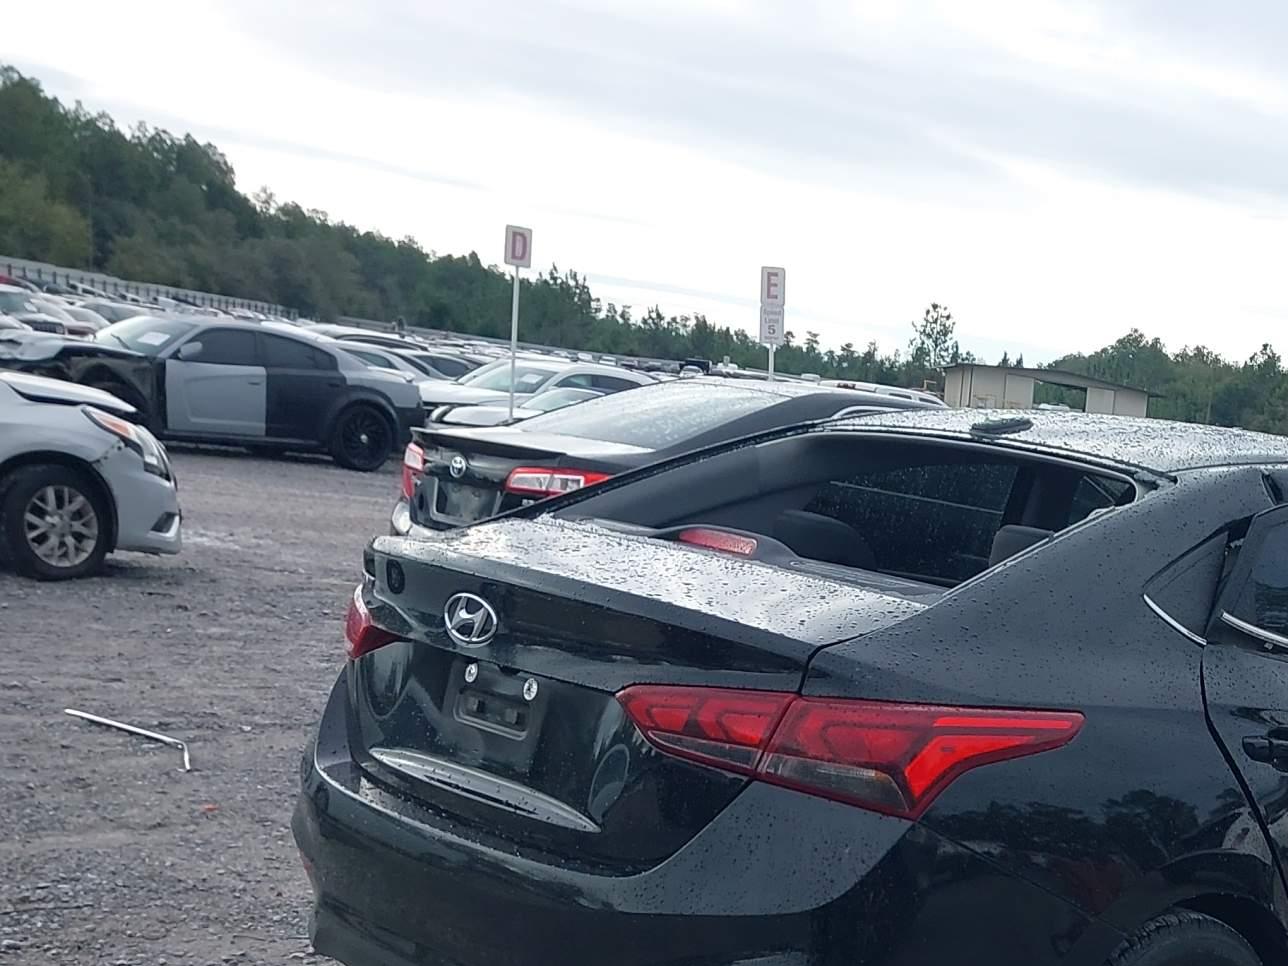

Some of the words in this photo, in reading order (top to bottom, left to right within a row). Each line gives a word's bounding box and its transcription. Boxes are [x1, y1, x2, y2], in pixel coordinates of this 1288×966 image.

[511, 231, 528, 261] D
[766, 271, 779, 300] E
[767, 324, 777, 336] 5
